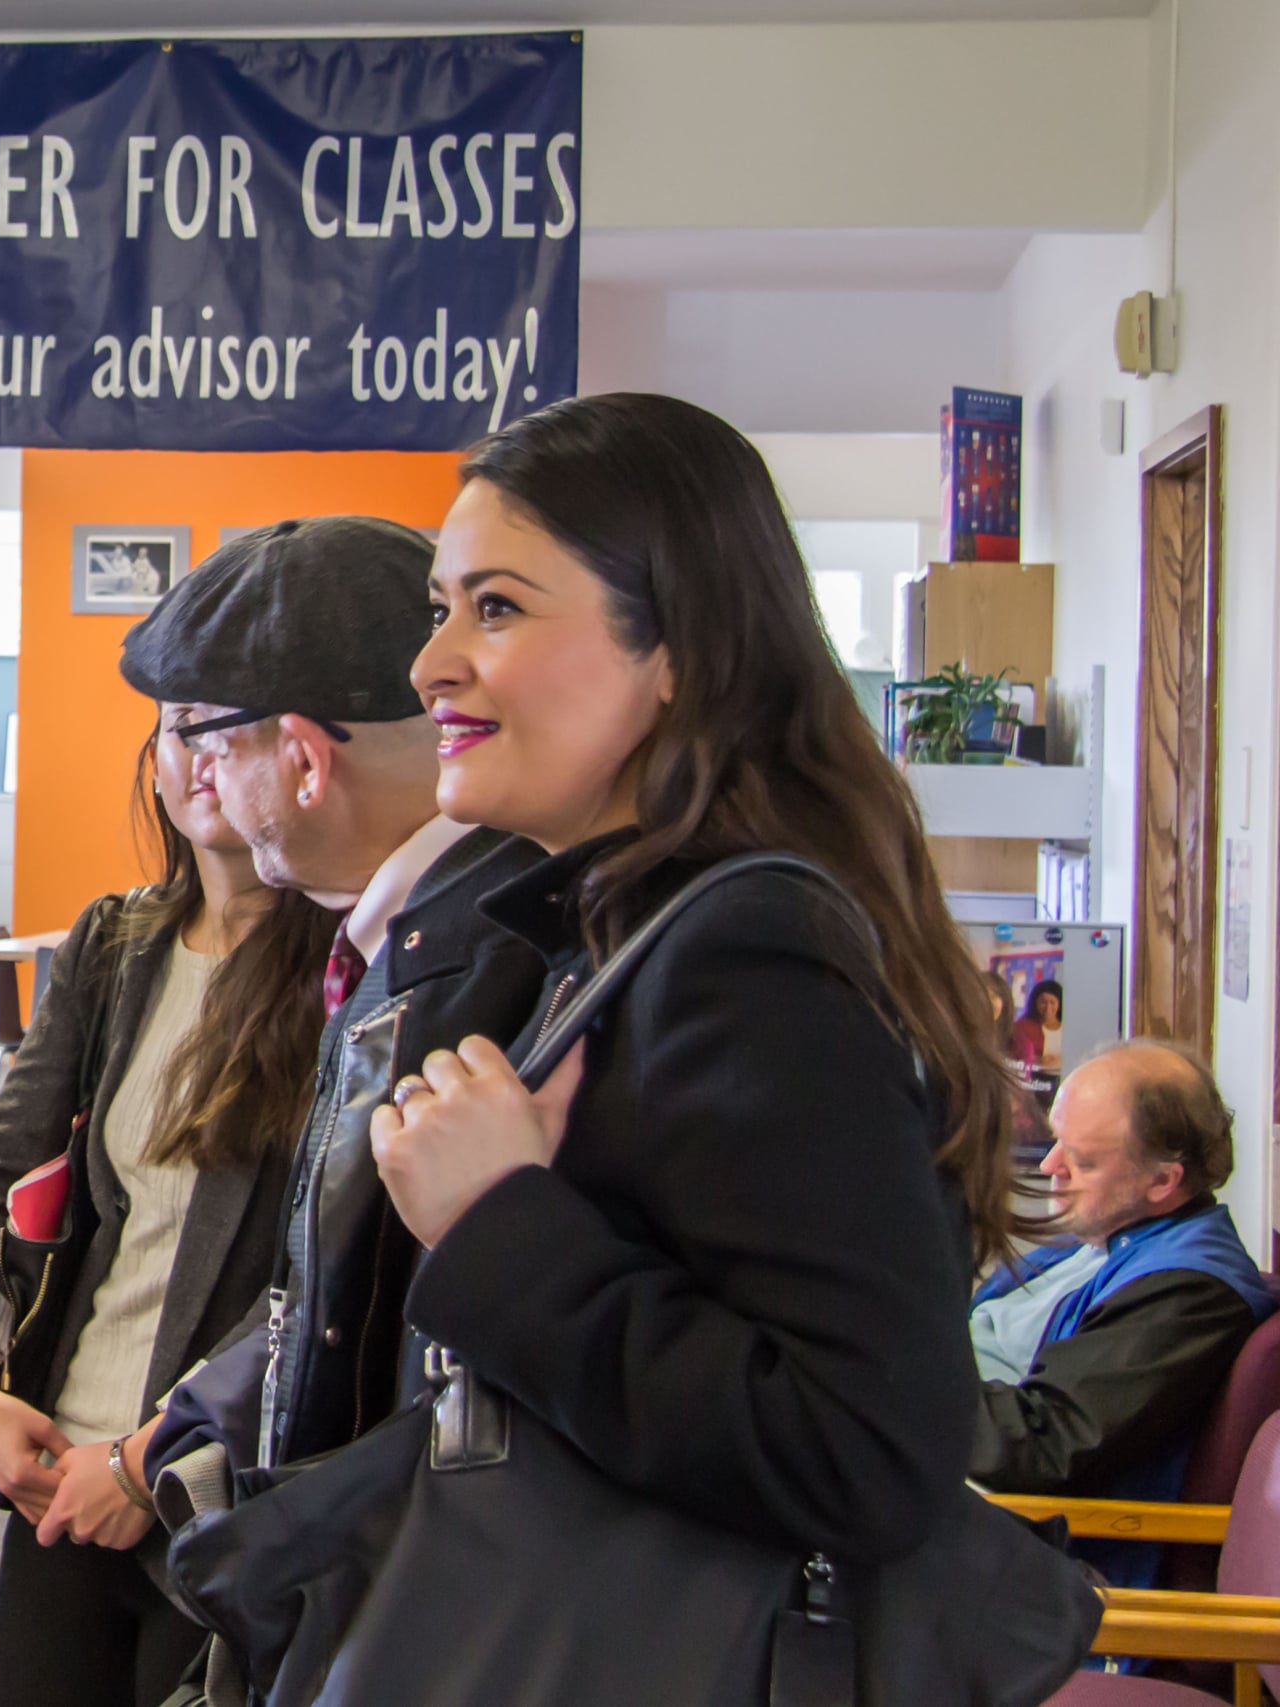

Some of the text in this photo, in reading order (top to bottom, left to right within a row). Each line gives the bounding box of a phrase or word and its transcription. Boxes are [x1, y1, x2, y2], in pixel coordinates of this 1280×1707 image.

[125, 134, 258, 241] FOR
[301, 132, 576, 240] CLASSES
[91, 305, 311, 401] advisor
[347, 306, 540, 434] today!
